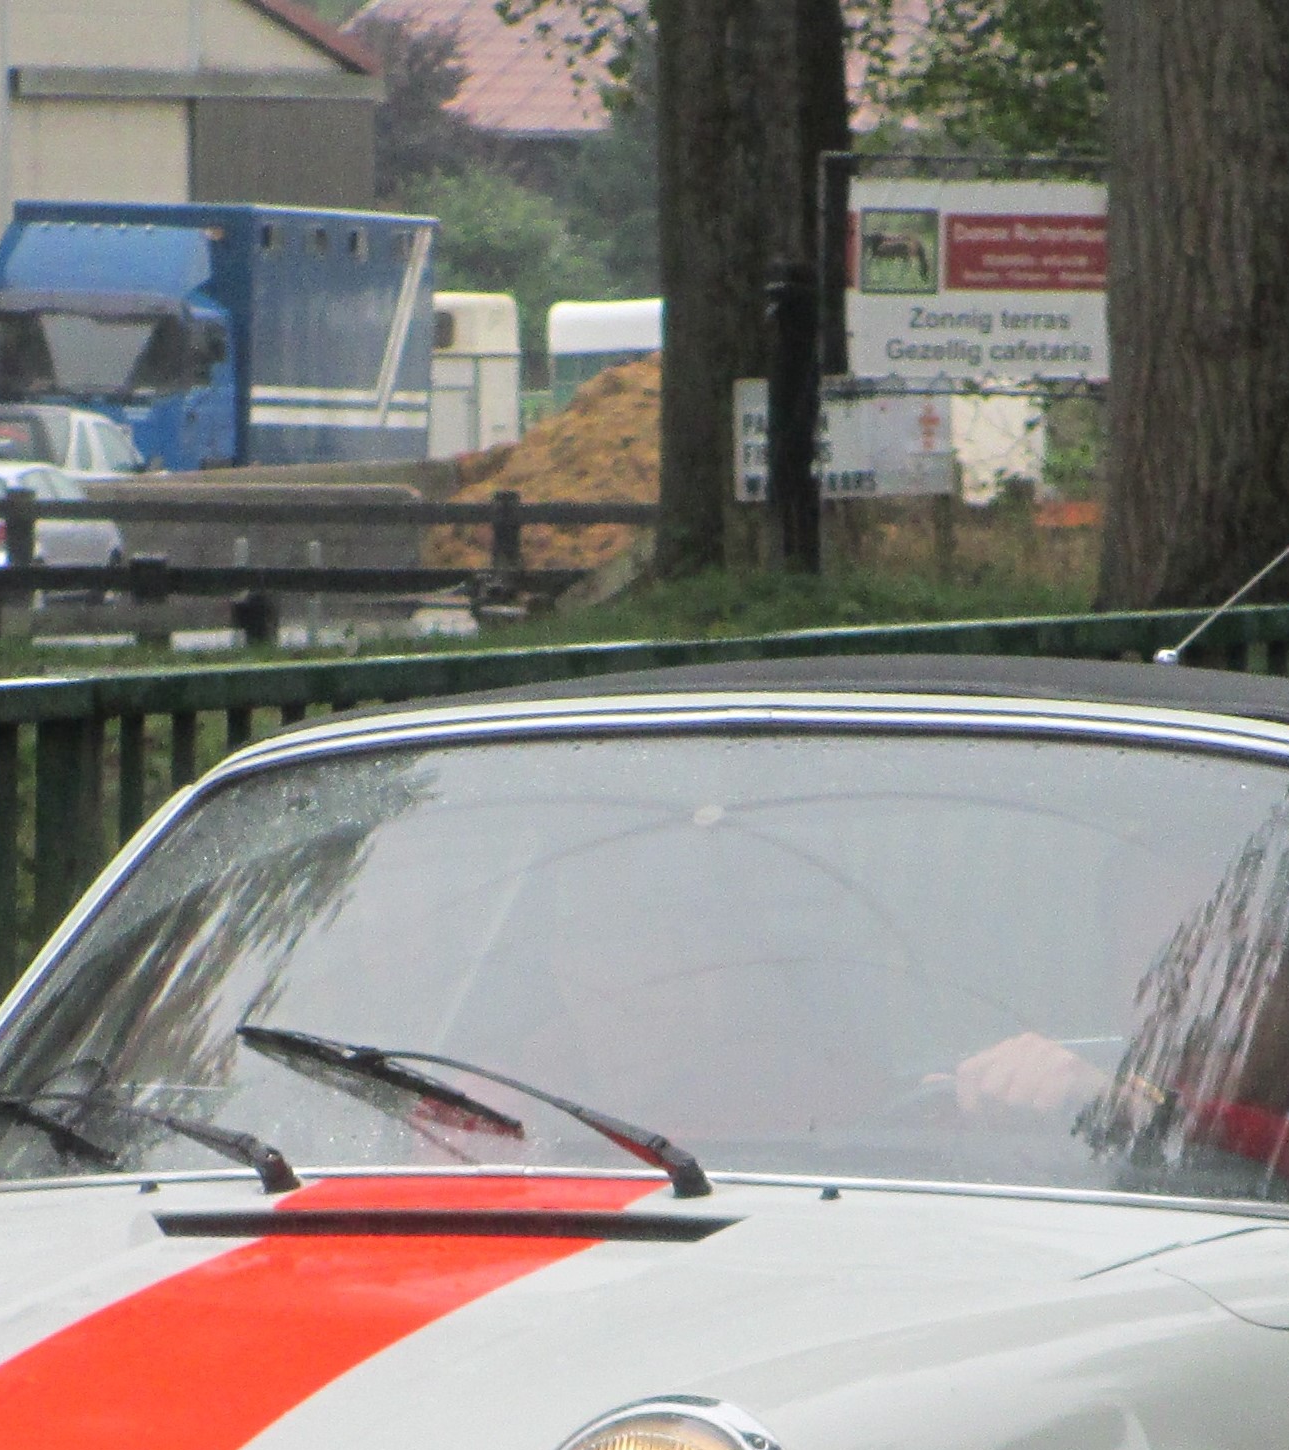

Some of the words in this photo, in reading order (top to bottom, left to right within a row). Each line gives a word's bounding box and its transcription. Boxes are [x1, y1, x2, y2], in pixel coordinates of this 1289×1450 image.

[910, 306, 992, 333] Zonnig
[1000, 309, 1070, 330] terras
[885, 338, 982, 366] Gezellig
[989, 339, 1092, 362] cafetaria
